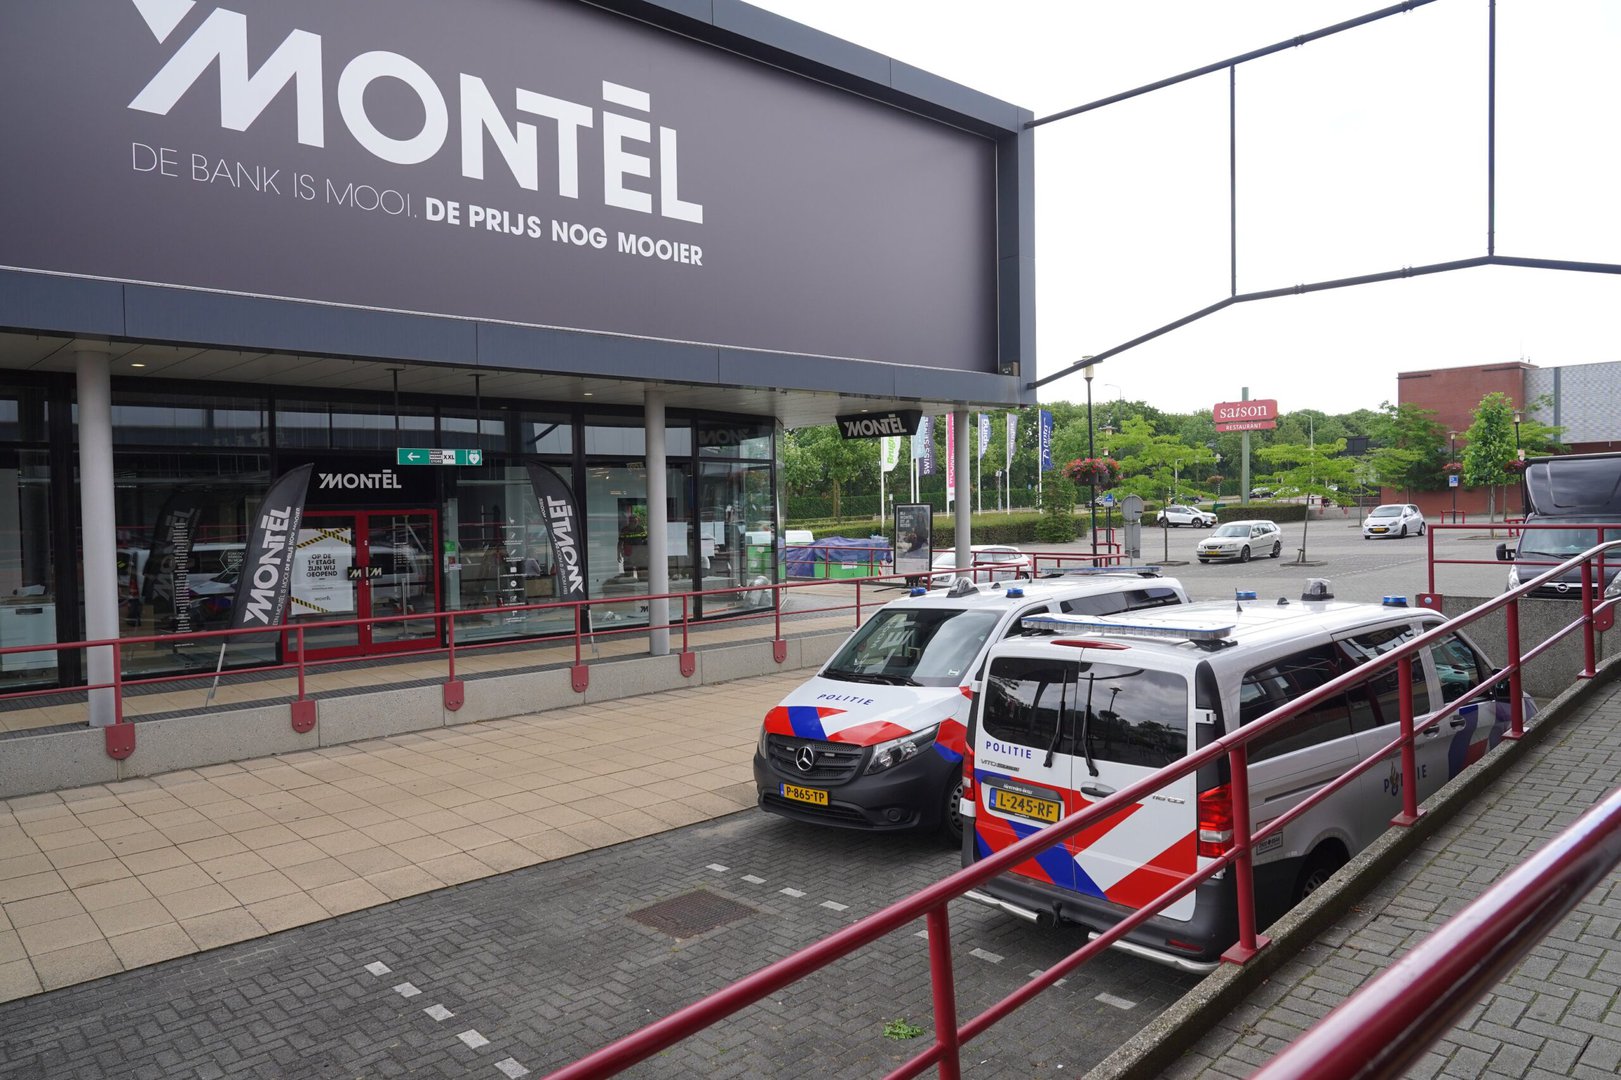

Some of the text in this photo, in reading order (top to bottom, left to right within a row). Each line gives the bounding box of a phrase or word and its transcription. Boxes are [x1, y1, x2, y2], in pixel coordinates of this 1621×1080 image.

[132, 142, 703, 266] DE BANK IS MOOI. DE PRIJS NOG MOOIER
[1220, 404, 1268, 419] saison
[816, 694, 874, 706] POLITIE
[986, 741, 1032, 759] POLITIE
[981, 759, 997, 767] VITO
[786, 786, 825, 802] P-865-TP
[1000, 793, 1054, 818] L-245-RF
